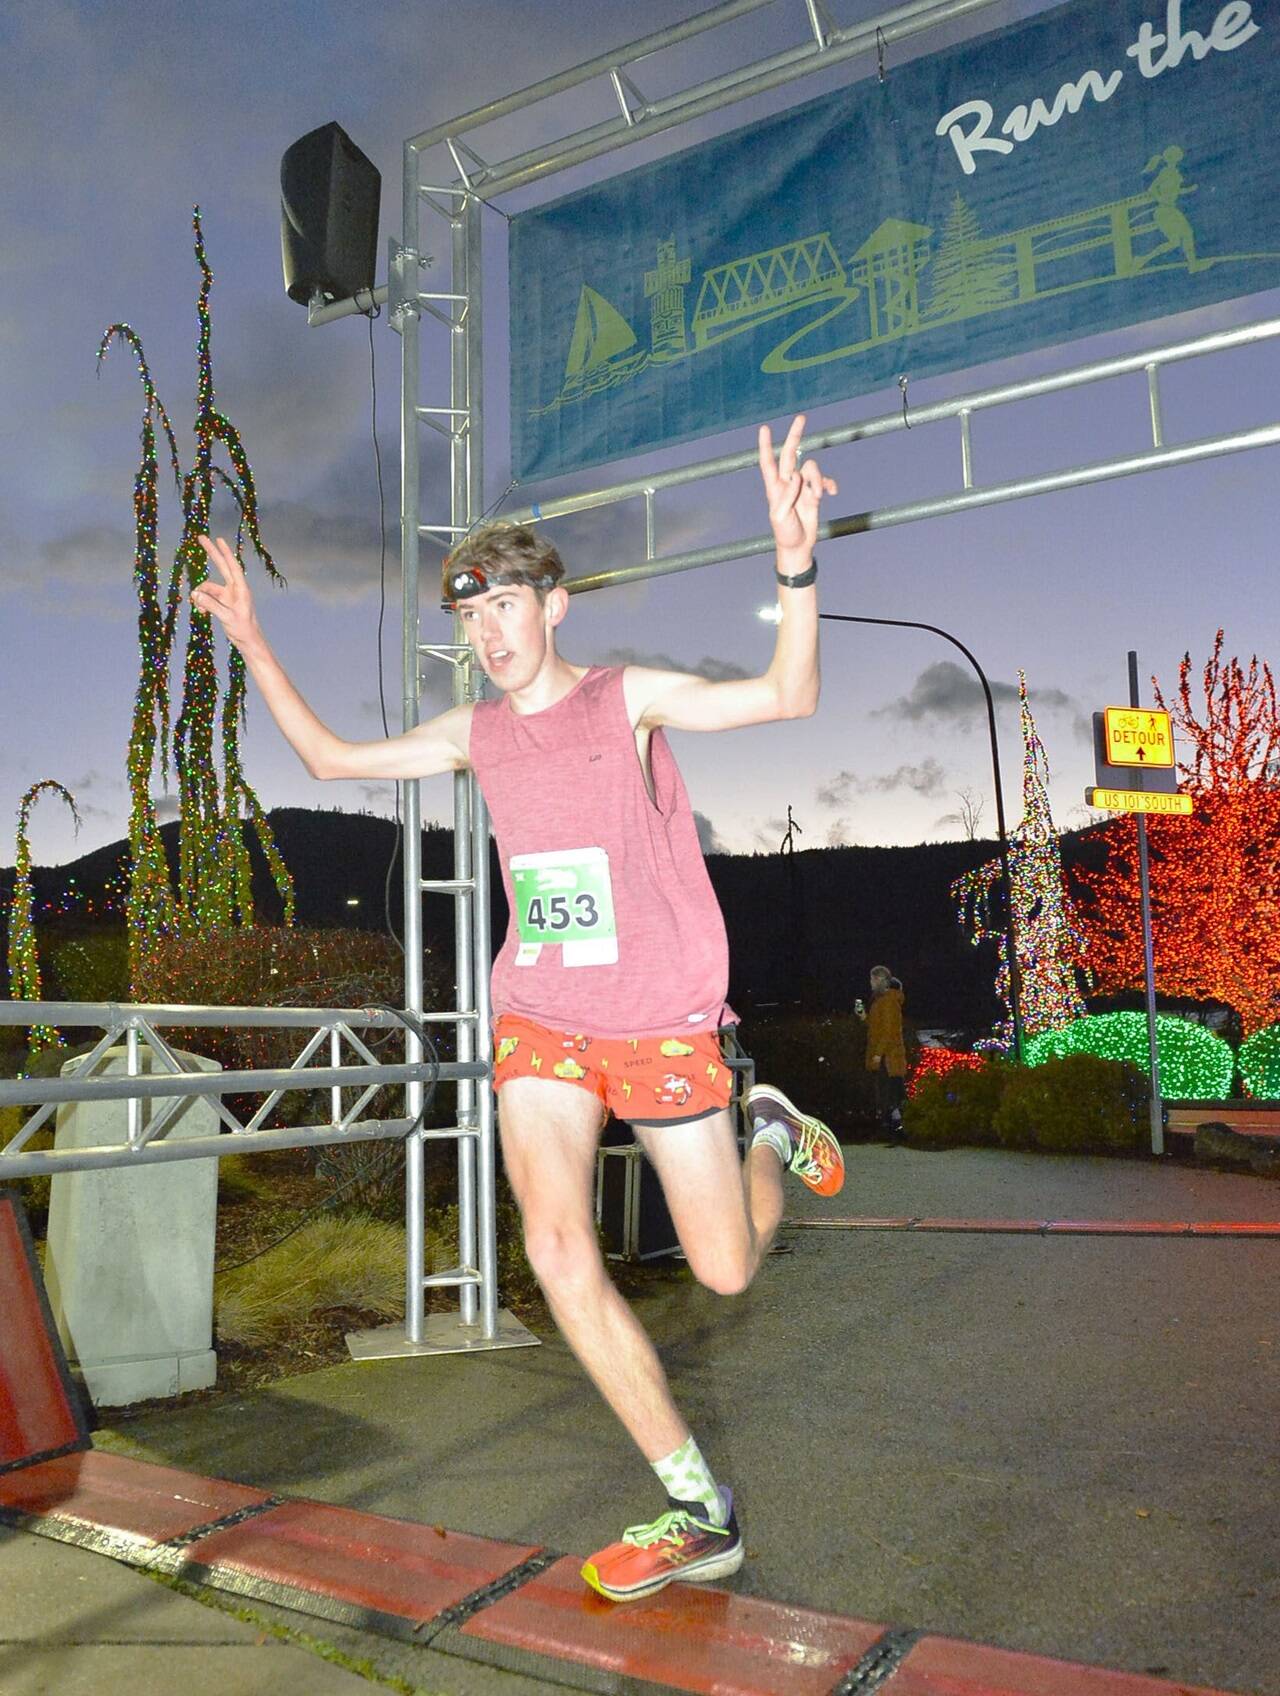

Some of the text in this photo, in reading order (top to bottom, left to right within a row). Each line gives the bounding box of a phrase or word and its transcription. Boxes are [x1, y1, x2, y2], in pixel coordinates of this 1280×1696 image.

[935, 0, 1261, 175] Run the
[1113, 730, 1165, 746] DETOUR
[1104, 793, 1182, 810] US 101 SOUTH
[527, 894, 599, 930] 453
[624, 1057, 653, 1069] SPEED
